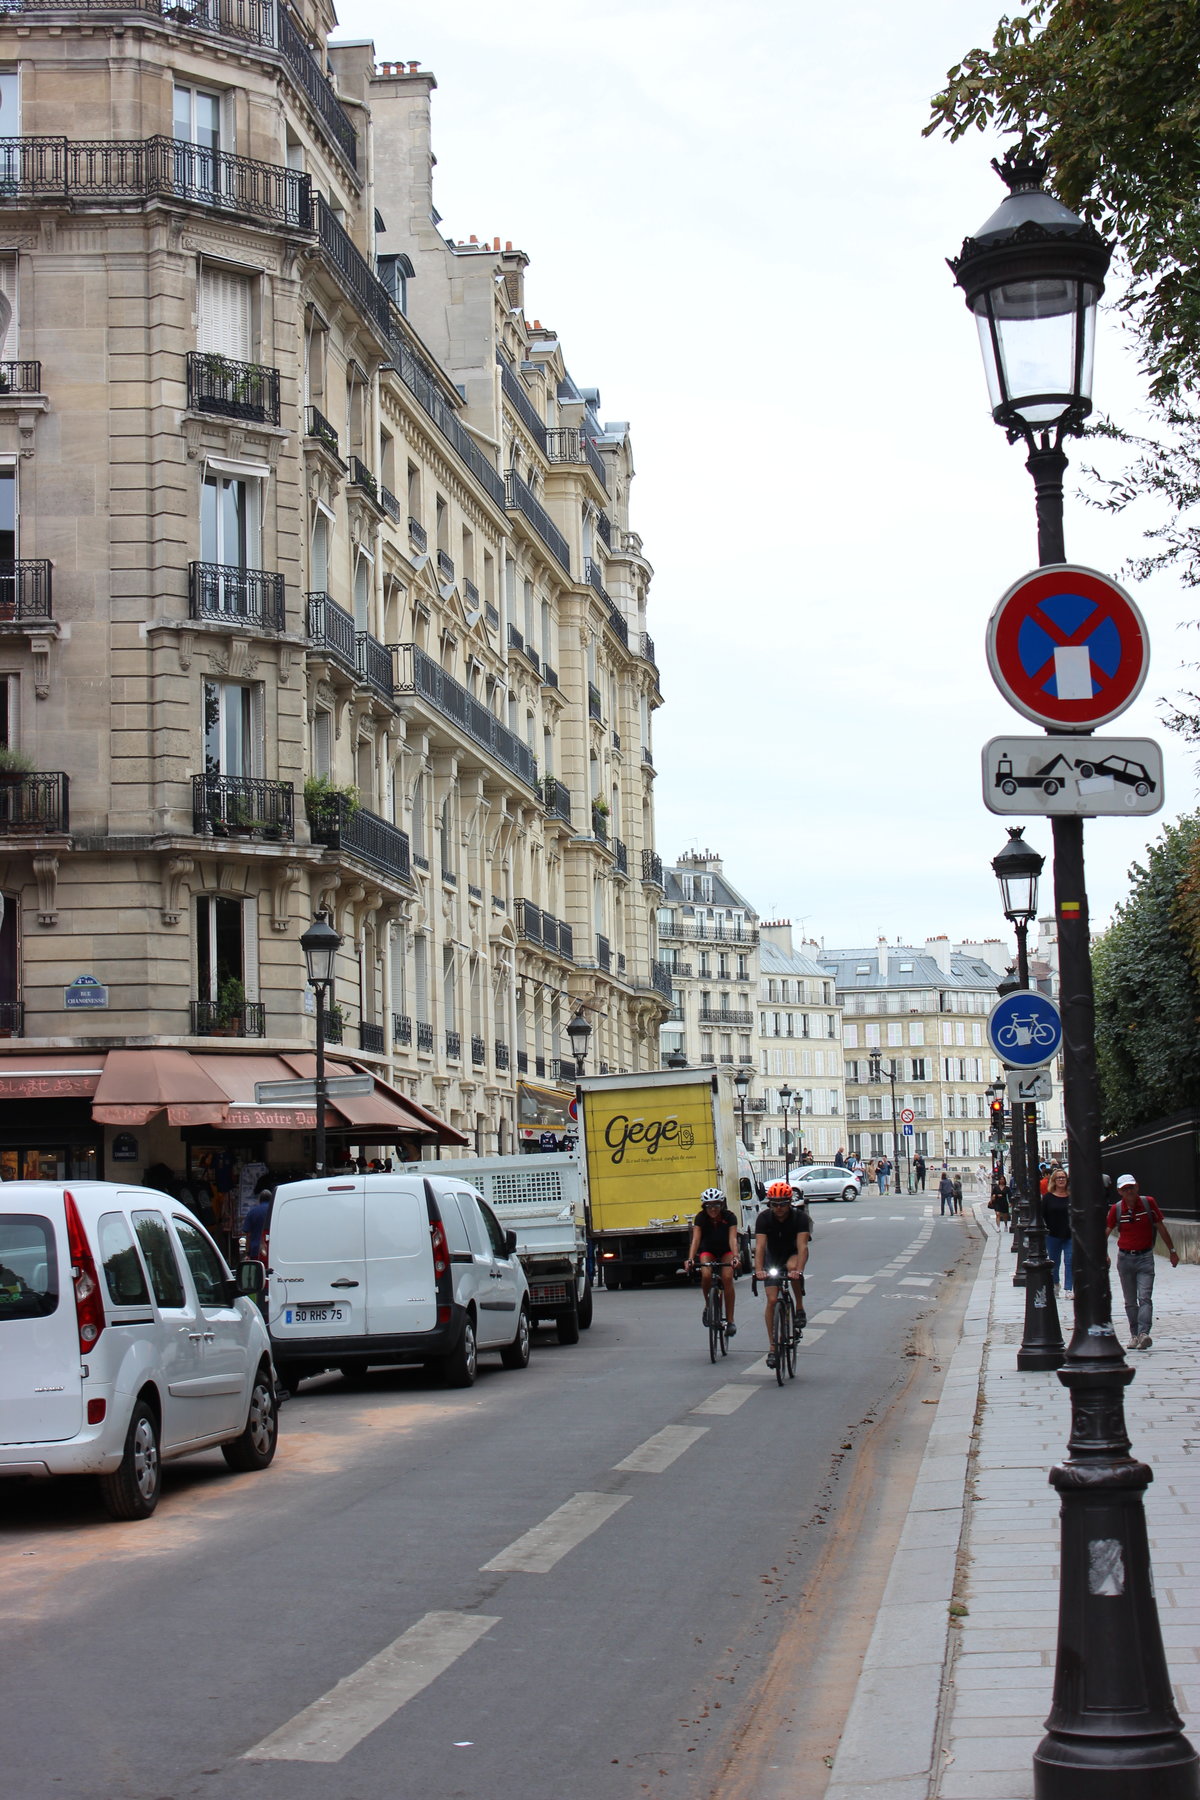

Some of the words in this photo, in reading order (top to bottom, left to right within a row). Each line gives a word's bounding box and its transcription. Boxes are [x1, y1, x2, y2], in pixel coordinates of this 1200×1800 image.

[254, 1111, 292, 1124] Notre
[605, 1114, 679, 1164] Gégé
[295, 1311, 306, 1321] 50
[310, 1310, 327, 1320] RHS
[331, 1309, 342, 1320] 75
